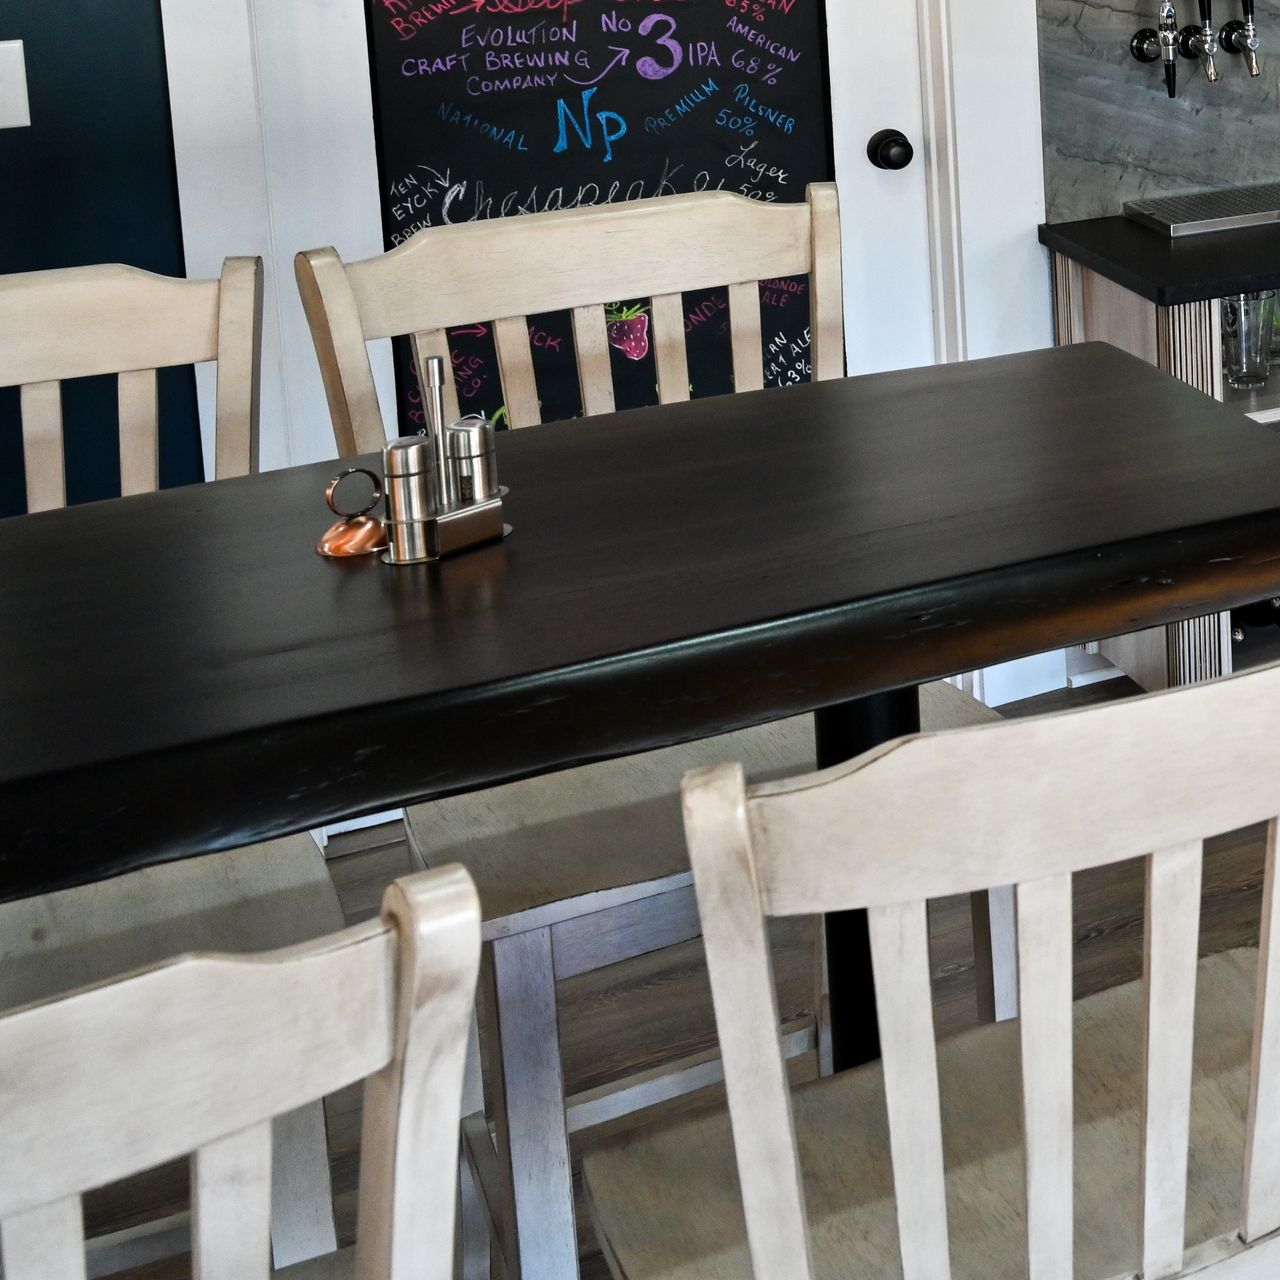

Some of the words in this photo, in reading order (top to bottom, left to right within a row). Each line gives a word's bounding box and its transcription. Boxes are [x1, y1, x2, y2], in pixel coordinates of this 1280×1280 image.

[461, 19, 578, 50] EVOLUTION
[635, 12, 684, 80] 3
[688, 40, 722, 67] IPA
[725, 15, 801, 63] AMERICAN
[401, 52, 472, 77] CRAFT
[484, 49, 591, 72] BREWING
[465, 72, 558, 96] COMPANY
[436, 101, 529, 152] NATIONAL
[644, 77, 721, 137] PREMIUM
[732, 82, 796, 136] PILSNER
[724, 140, 790, 187] Lager
[389, 173, 420, 198] TEN
[390, 181, 439, 221] EYCK
[761, 290, 791, 308] ALE
